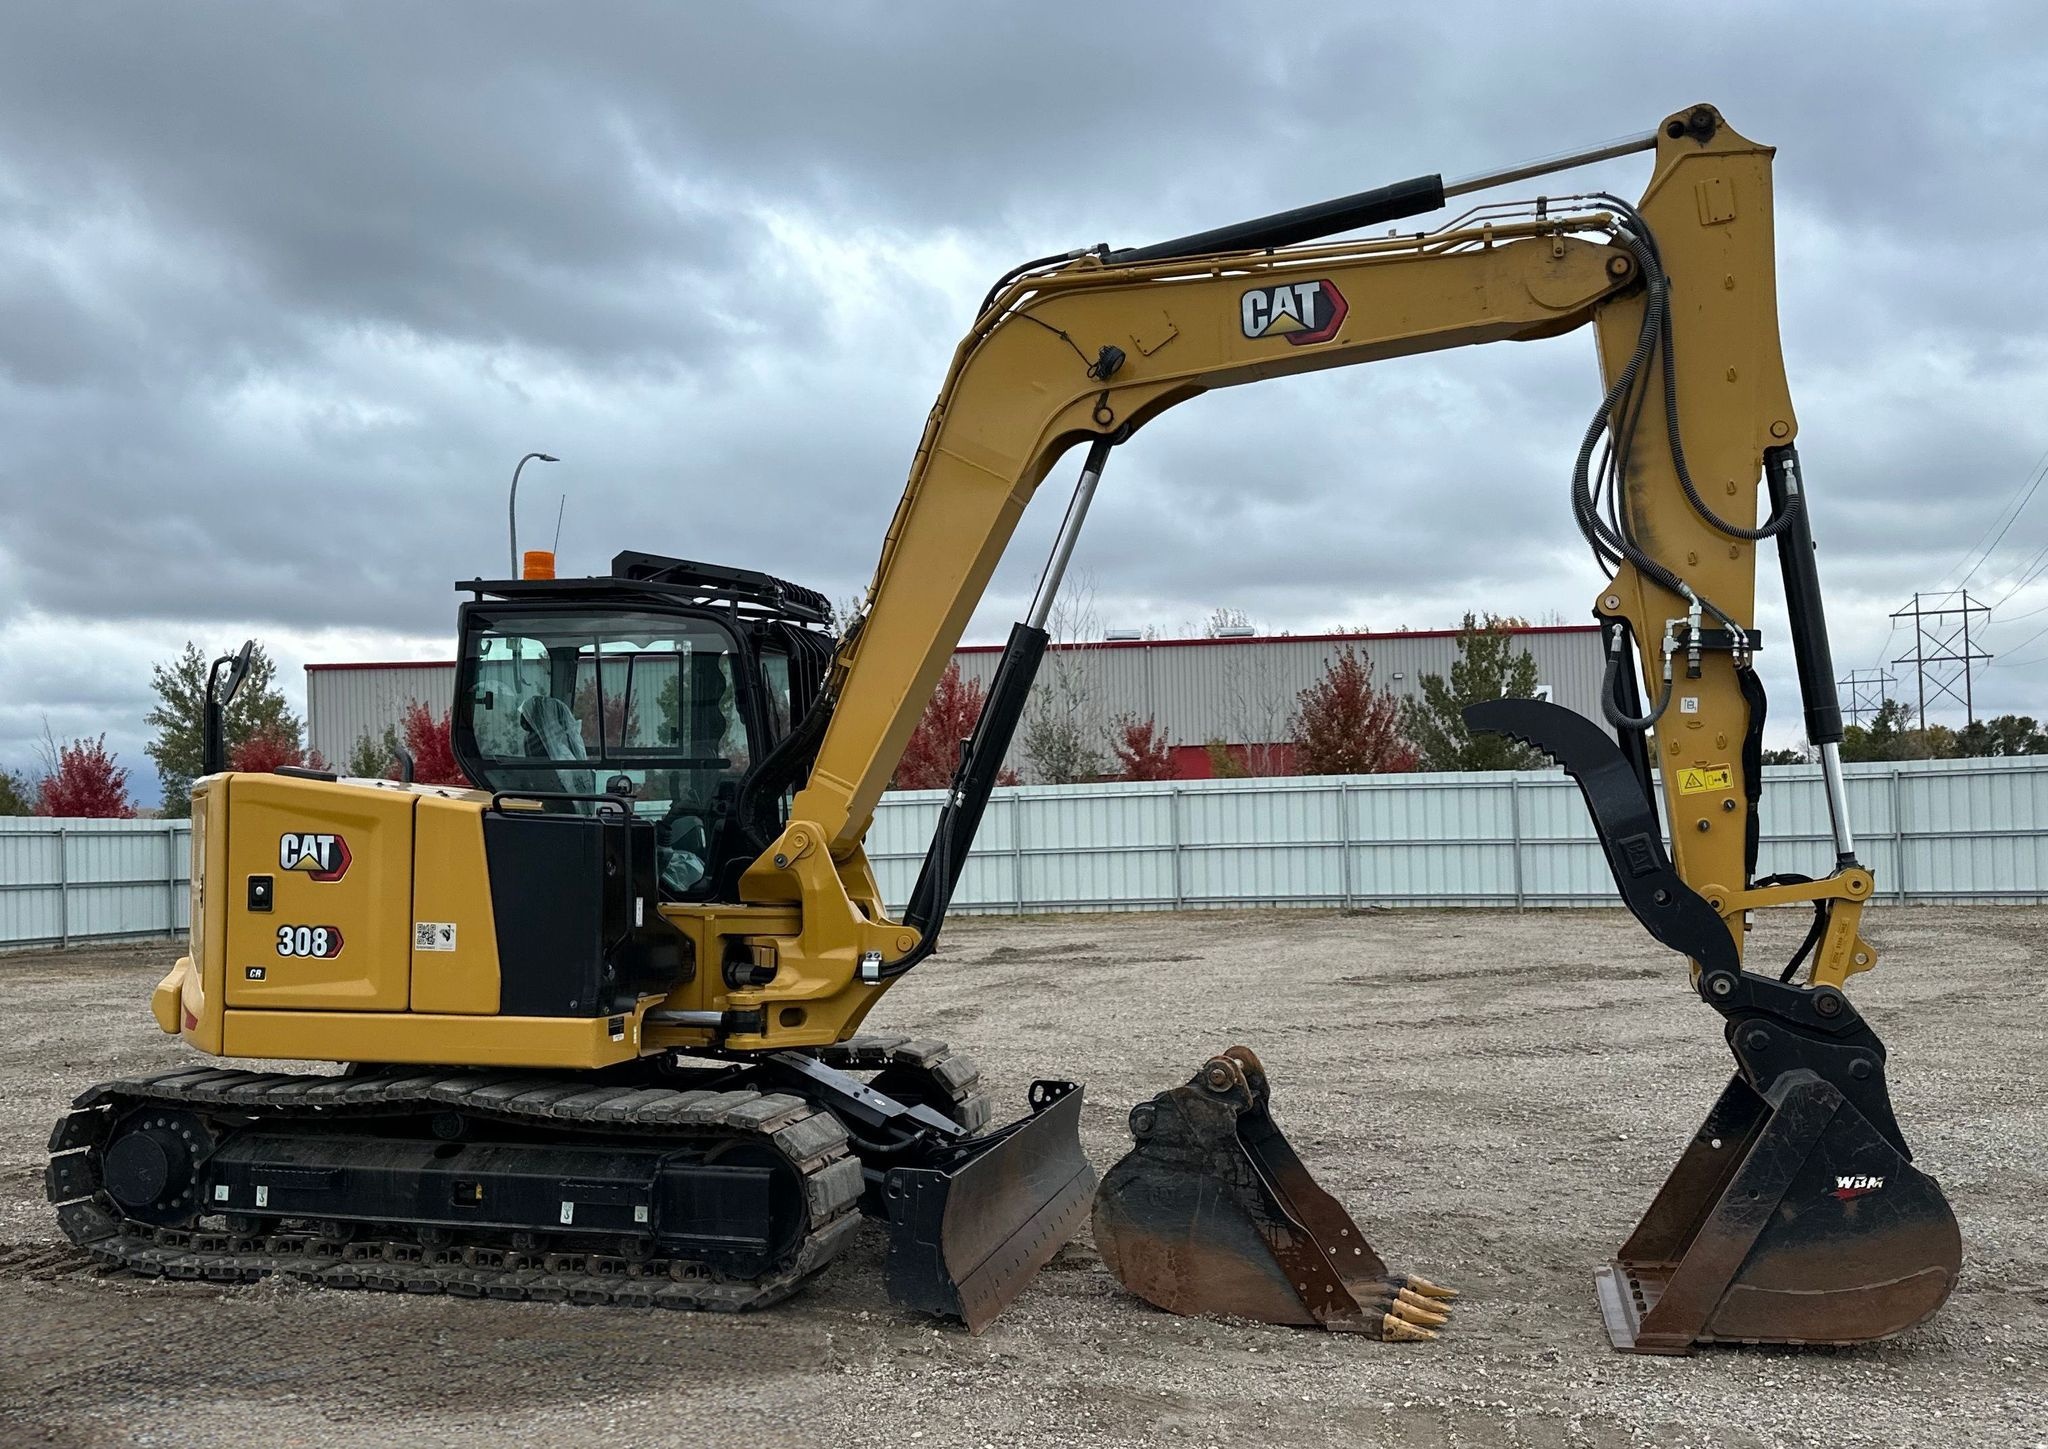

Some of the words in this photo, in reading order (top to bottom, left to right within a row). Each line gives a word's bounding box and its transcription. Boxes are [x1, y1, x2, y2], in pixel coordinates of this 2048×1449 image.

[1242, 281, 1320, 338] CAT
[281, 834, 334, 870] CAT
[278, 926, 328, 957] 308
[250, 969, 262, 978] CR
